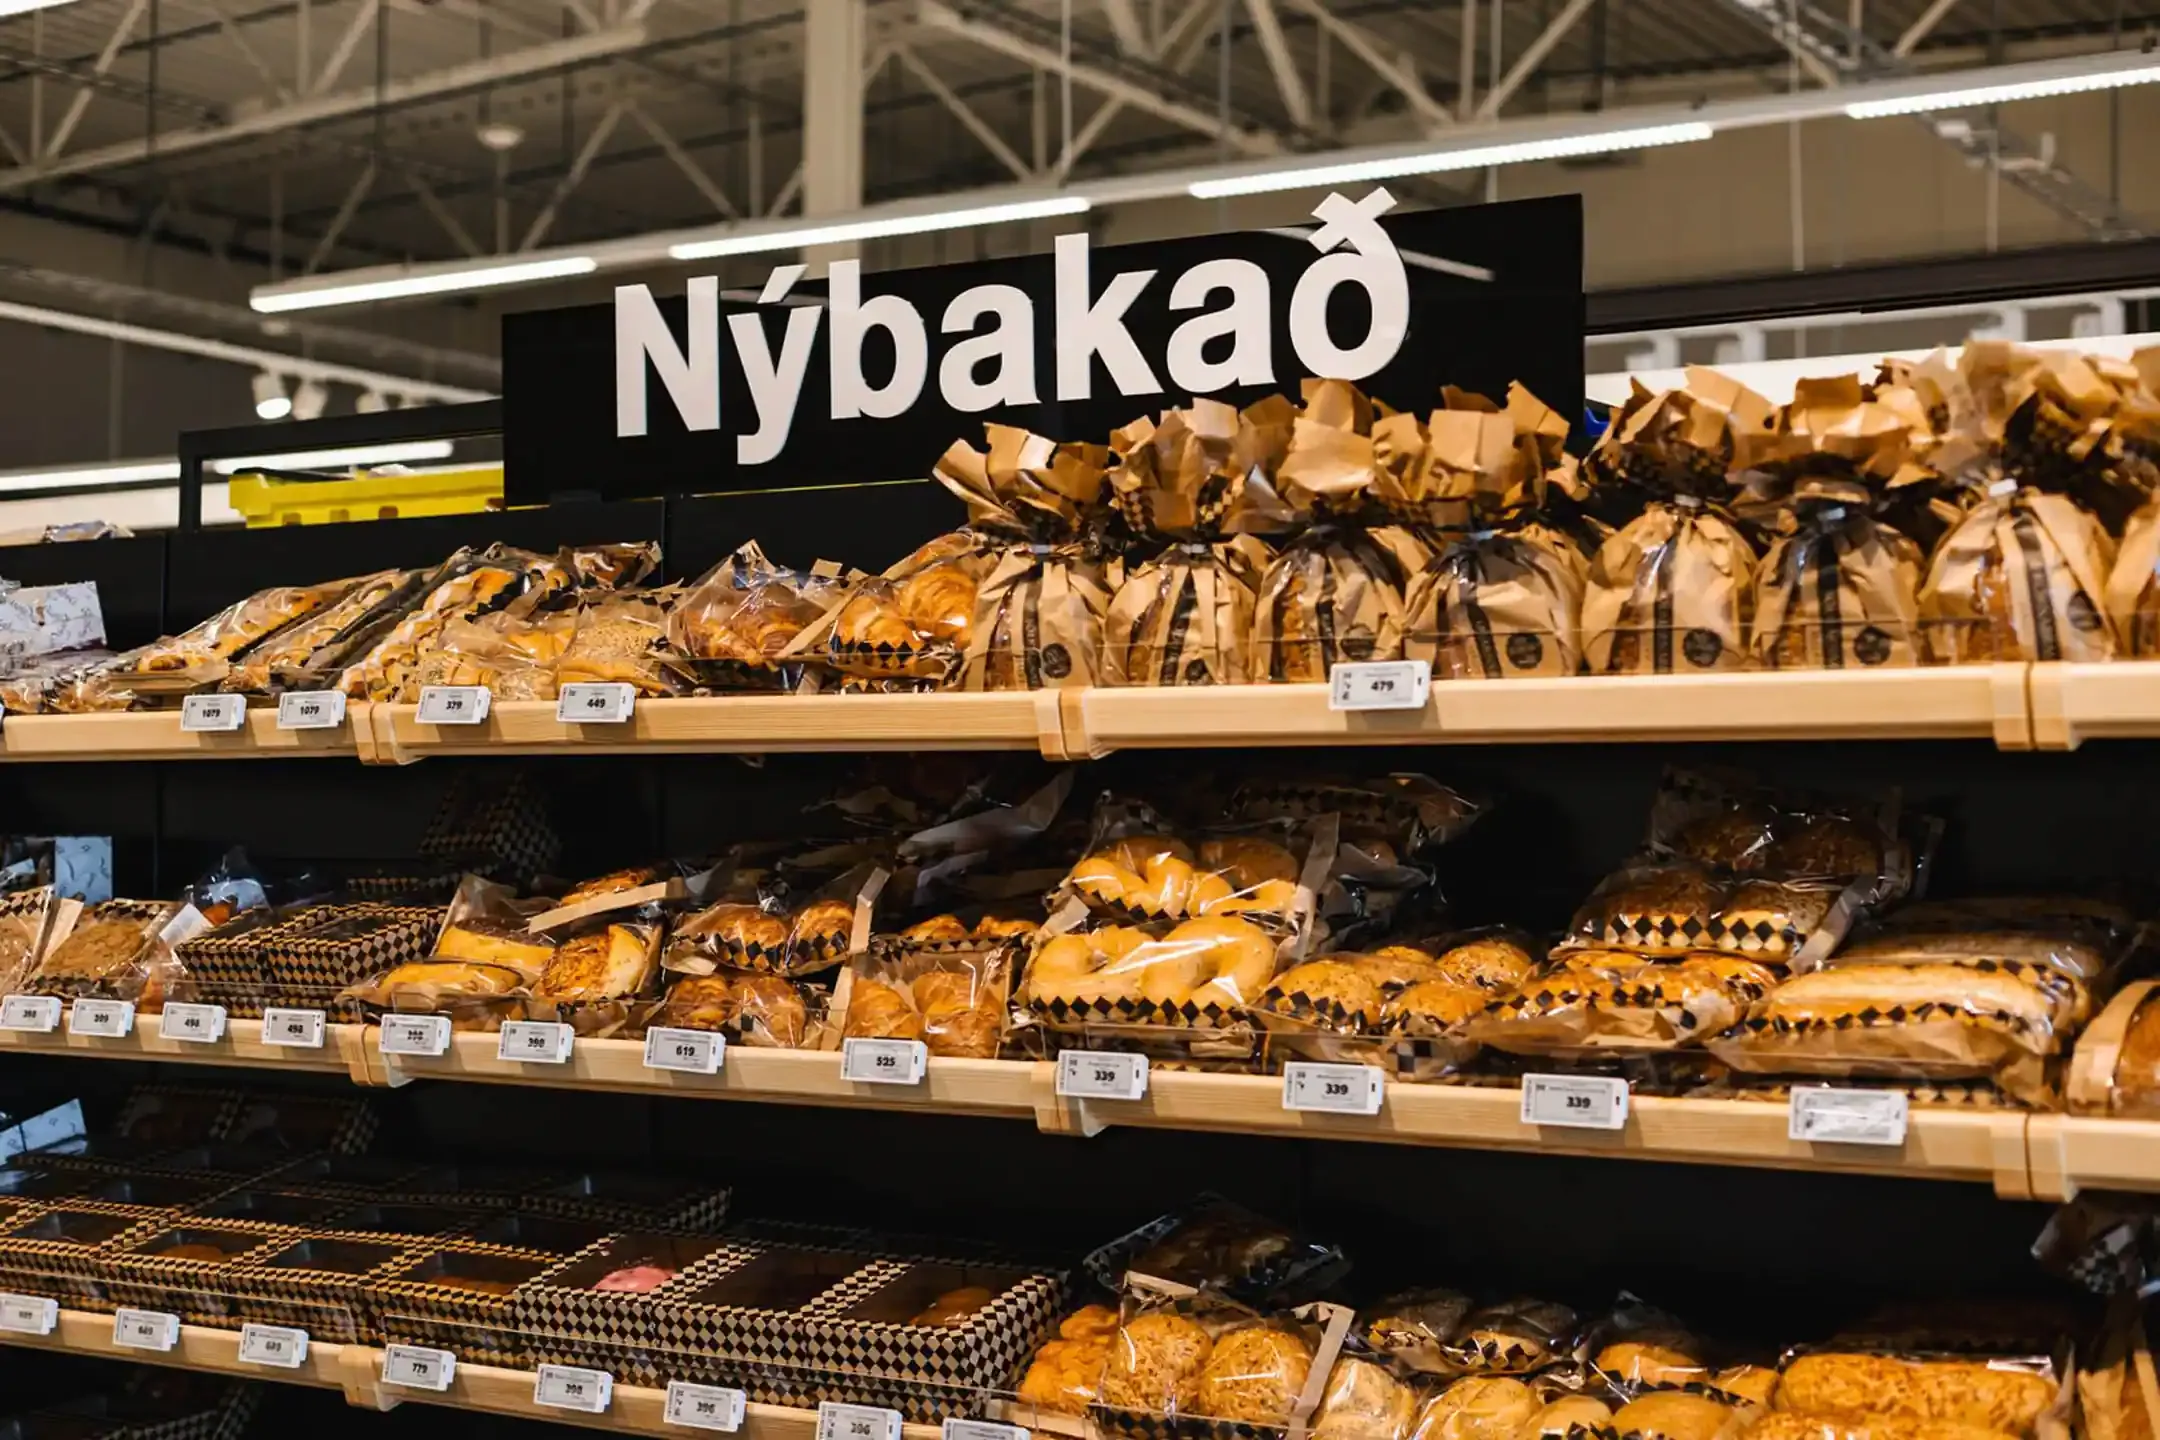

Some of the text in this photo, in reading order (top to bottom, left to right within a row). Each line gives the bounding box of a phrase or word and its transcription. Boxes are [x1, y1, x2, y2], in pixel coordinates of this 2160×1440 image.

[615, 187, 1410, 465] Nýbakað
[1371, 681, 1394, 690] 479
[446, 700, 462, 710] 379
[587, 698, 605, 709] 449
[676, 1045, 695, 1057] 619
[876, 1056, 896, 1068] 525
[1094, 1070, 1115, 1082] 339
[1325, 1083, 1349, 1096] 339
[1566, 1096, 1592, 1109] 339
